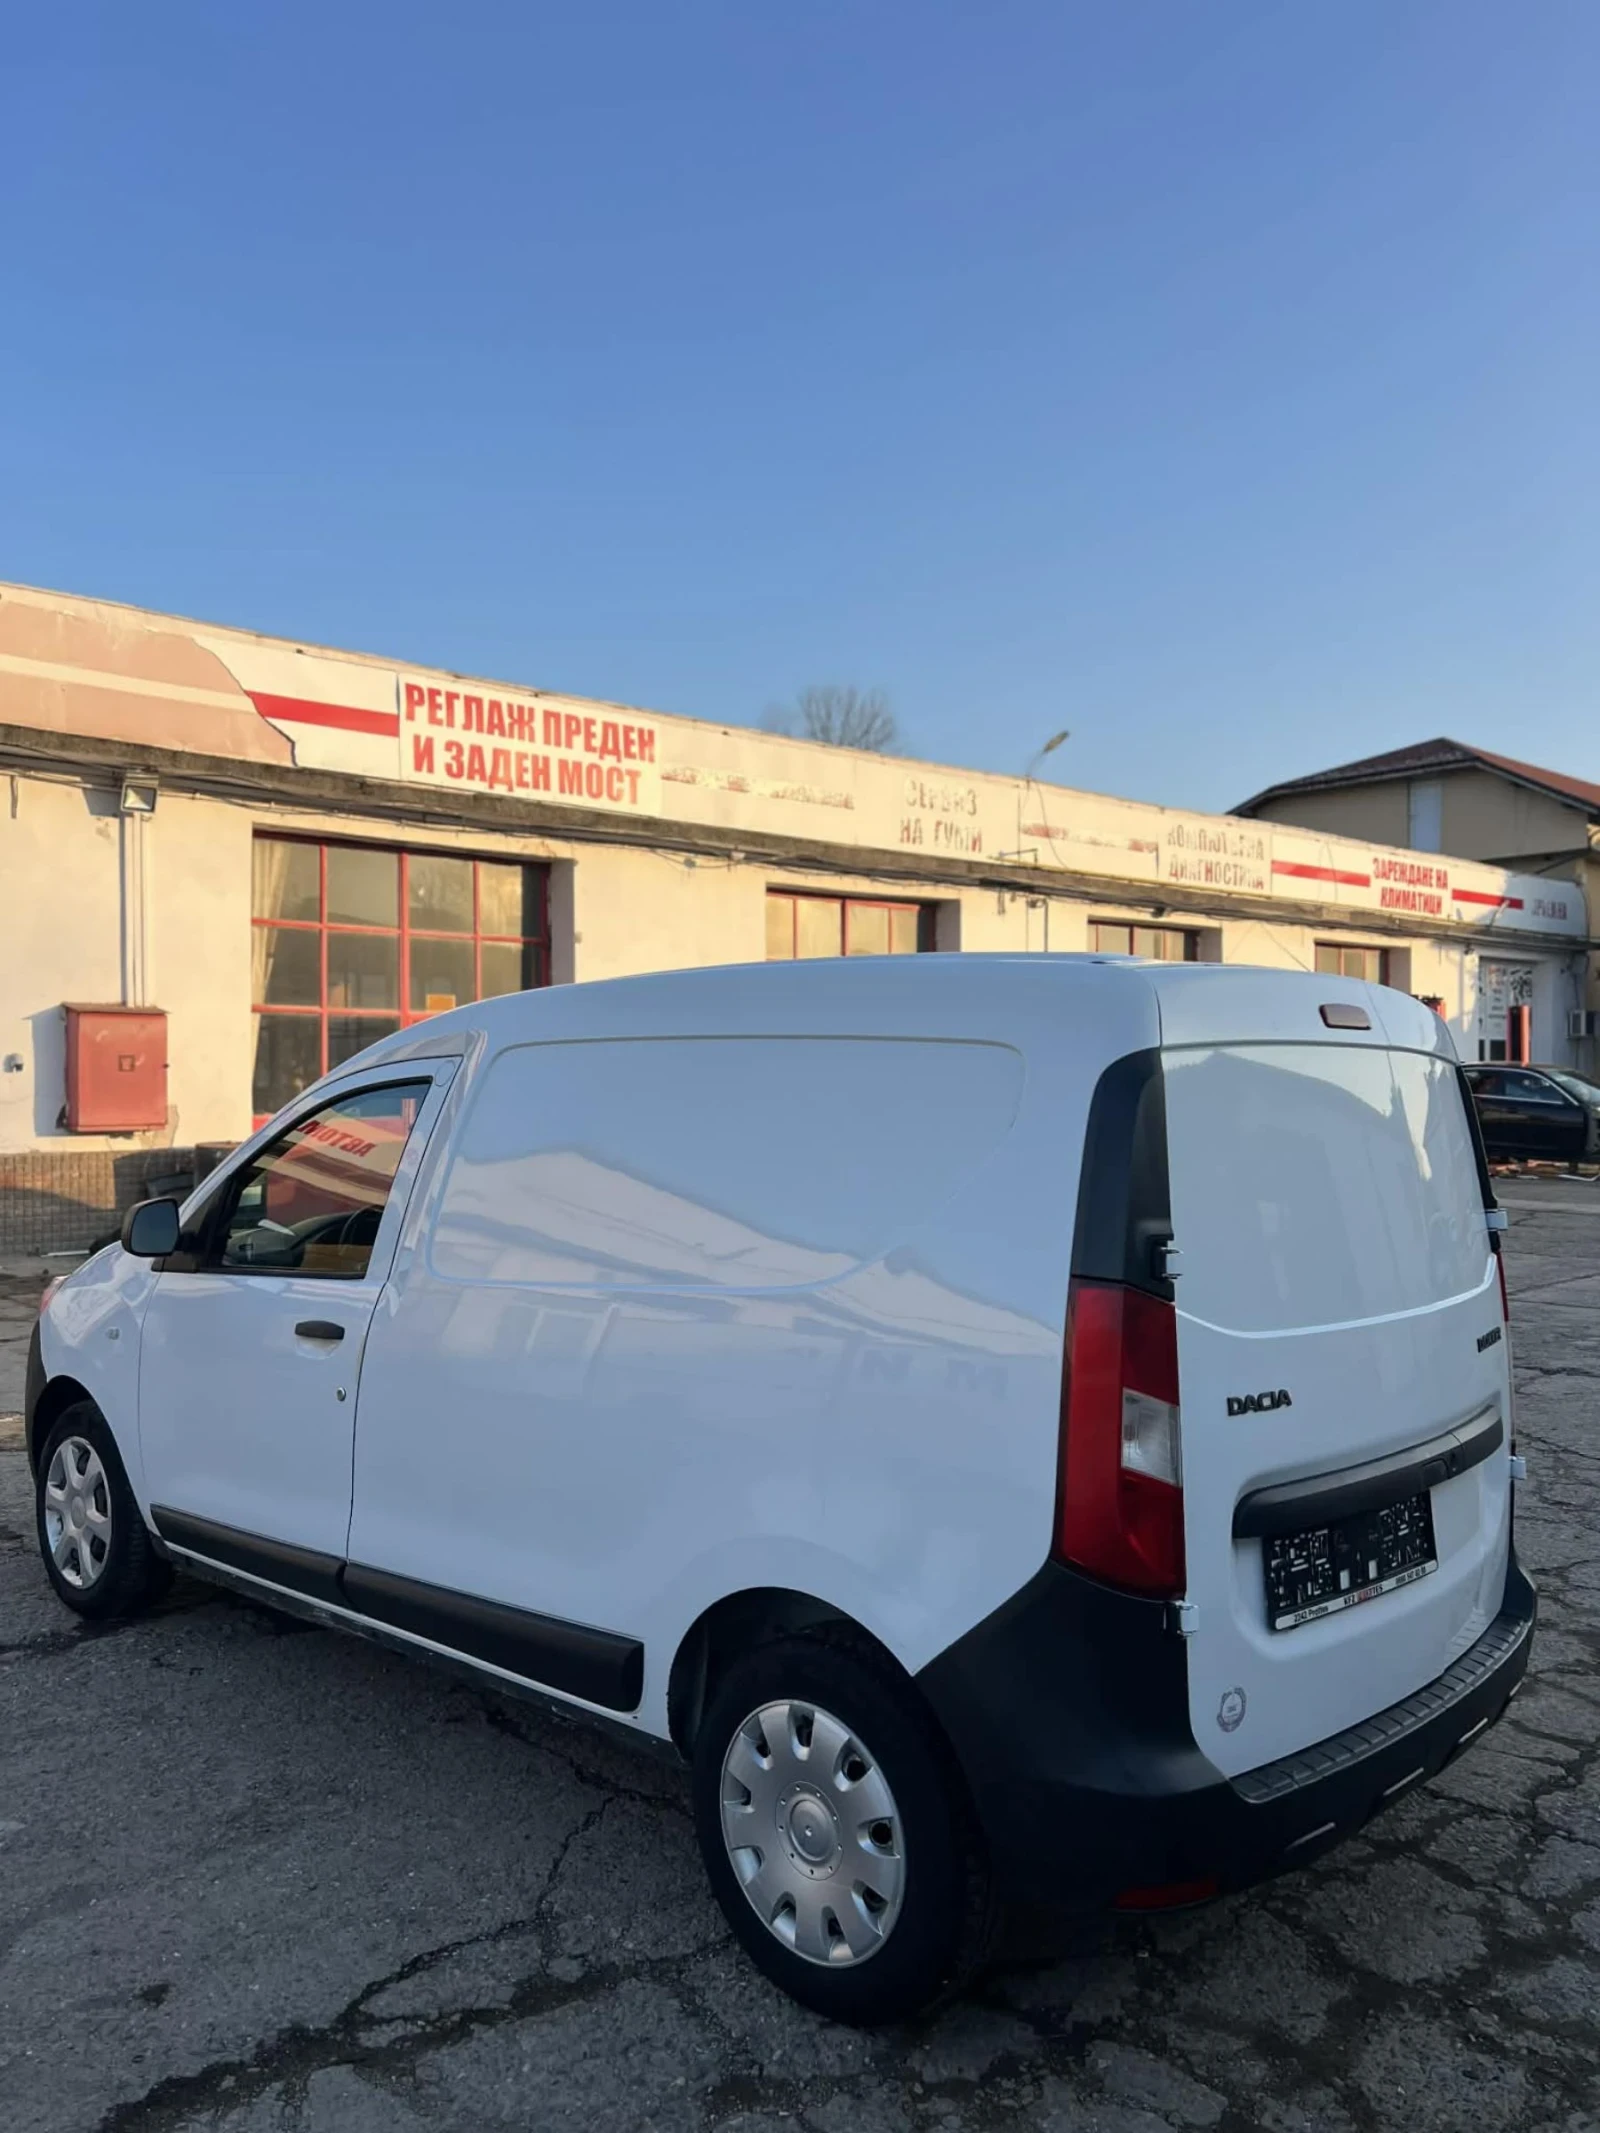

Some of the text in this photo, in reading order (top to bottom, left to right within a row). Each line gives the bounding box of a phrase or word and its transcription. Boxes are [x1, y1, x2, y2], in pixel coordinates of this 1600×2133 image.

[405, 683, 655, 763] РЕГЛАЖ ПРЕДЕН
[413, 734, 434, 774] И
[444, 740, 551, 792] ЗАДЕН
[558, 758, 642, 805] МОСТ
[1373, 857, 1448, 889] ЗАРЕЖДАНЕ НА
[1380, 887, 1442, 914] КЛИМАТИЦИ
[1227, 1389, 1292, 1416] DACIA
